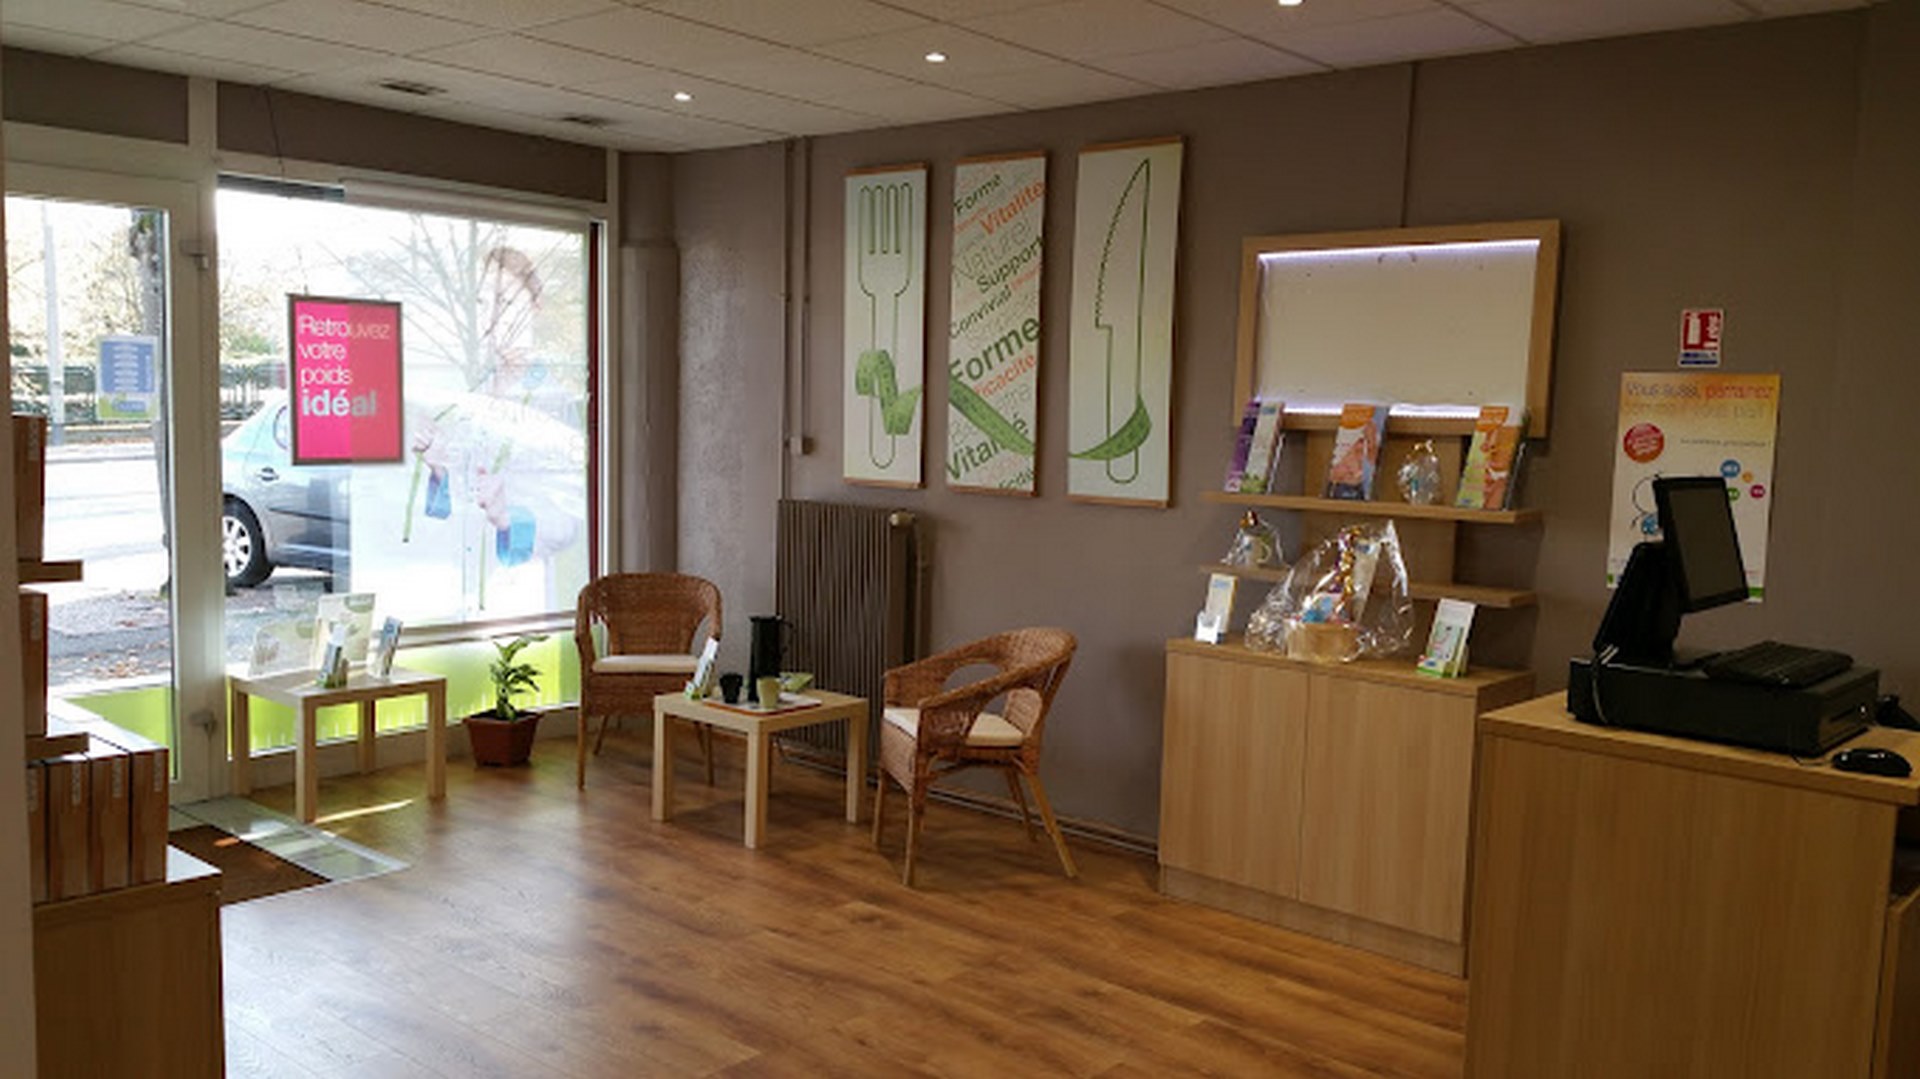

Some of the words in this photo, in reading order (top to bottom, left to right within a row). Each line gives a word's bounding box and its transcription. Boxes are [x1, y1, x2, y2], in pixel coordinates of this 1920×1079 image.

[953, 174, 1001, 215] Forme
[980, 180, 1045, 235] Vitalité
[976, 236, 1044, 293] Support
[298, 315, 390, 340] Retrouvez
[299, 342, 347, 361] votre
[949, 317, 1041, 382] Forme
[301, 365, 352, 387] poids
[302, 388, 377, 417] idéal
